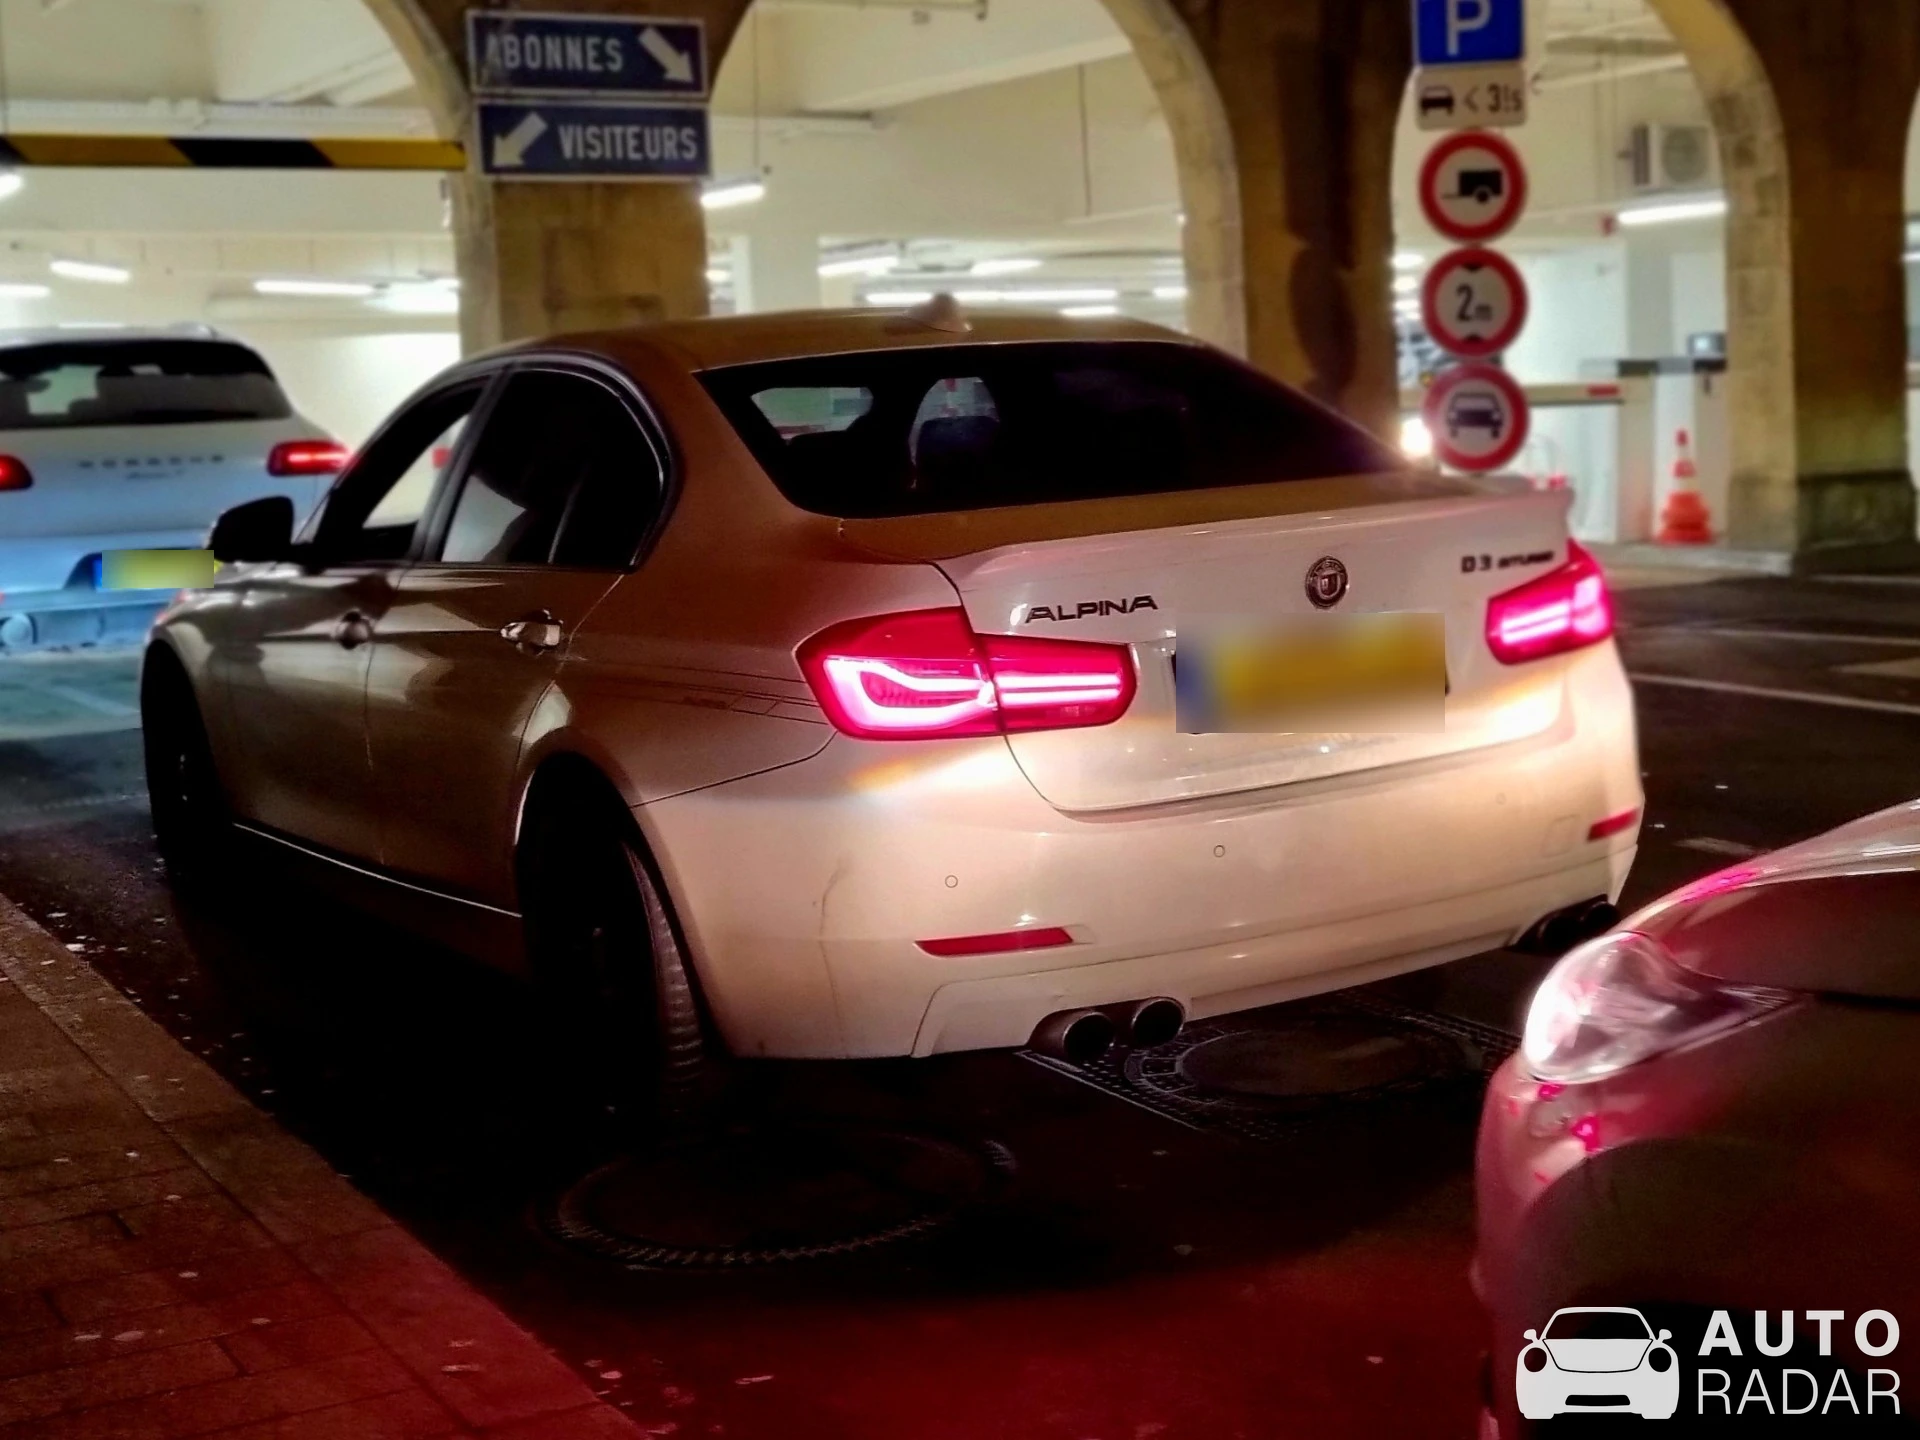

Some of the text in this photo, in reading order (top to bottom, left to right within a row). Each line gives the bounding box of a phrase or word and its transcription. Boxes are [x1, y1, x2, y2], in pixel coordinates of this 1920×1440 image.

[1446, 0, 1491, 55] P
[487, 33, 624, 72] ABONNES
[557, 123, 698, 160] VISITEURS
[1025, 595, 1158, 623] ALPINA
